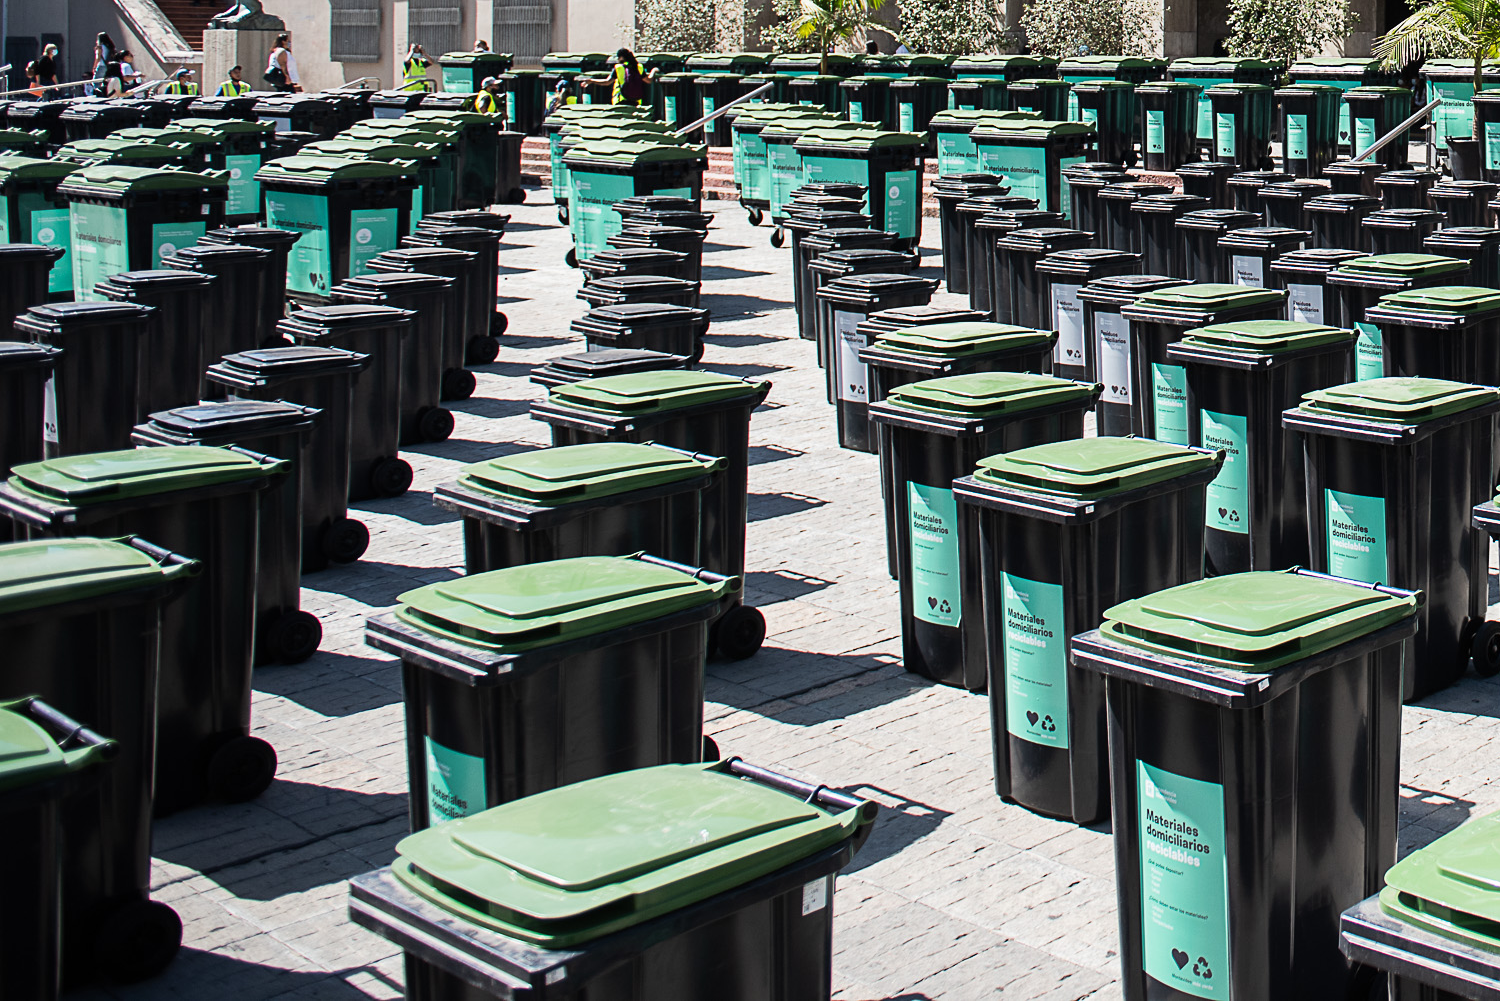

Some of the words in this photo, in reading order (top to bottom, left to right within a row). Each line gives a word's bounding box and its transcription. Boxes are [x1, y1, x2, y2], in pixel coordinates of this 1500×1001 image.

[984, 165, 1009, 173] Materiales
[1156, 384, 1182, 394] Materiales
[1205, 434, 1233, 447] Materiales
[913, 511, 942, 525] Materiales
[914, 520, 948, 535] domiciliarios
[1332, 519, 1368, 533] Materiales
[1332, 529, 1376, 544] domiciliarios
[1007, 607, 1045, 626] Materiales
[1008, 619, 1053, 638] domiciliarios
[1146, 809, 1199, 837] Materiales
[1147, 823, 1210, 854] domiciliarios
[1147, 839, 1200, 867] reciclables
